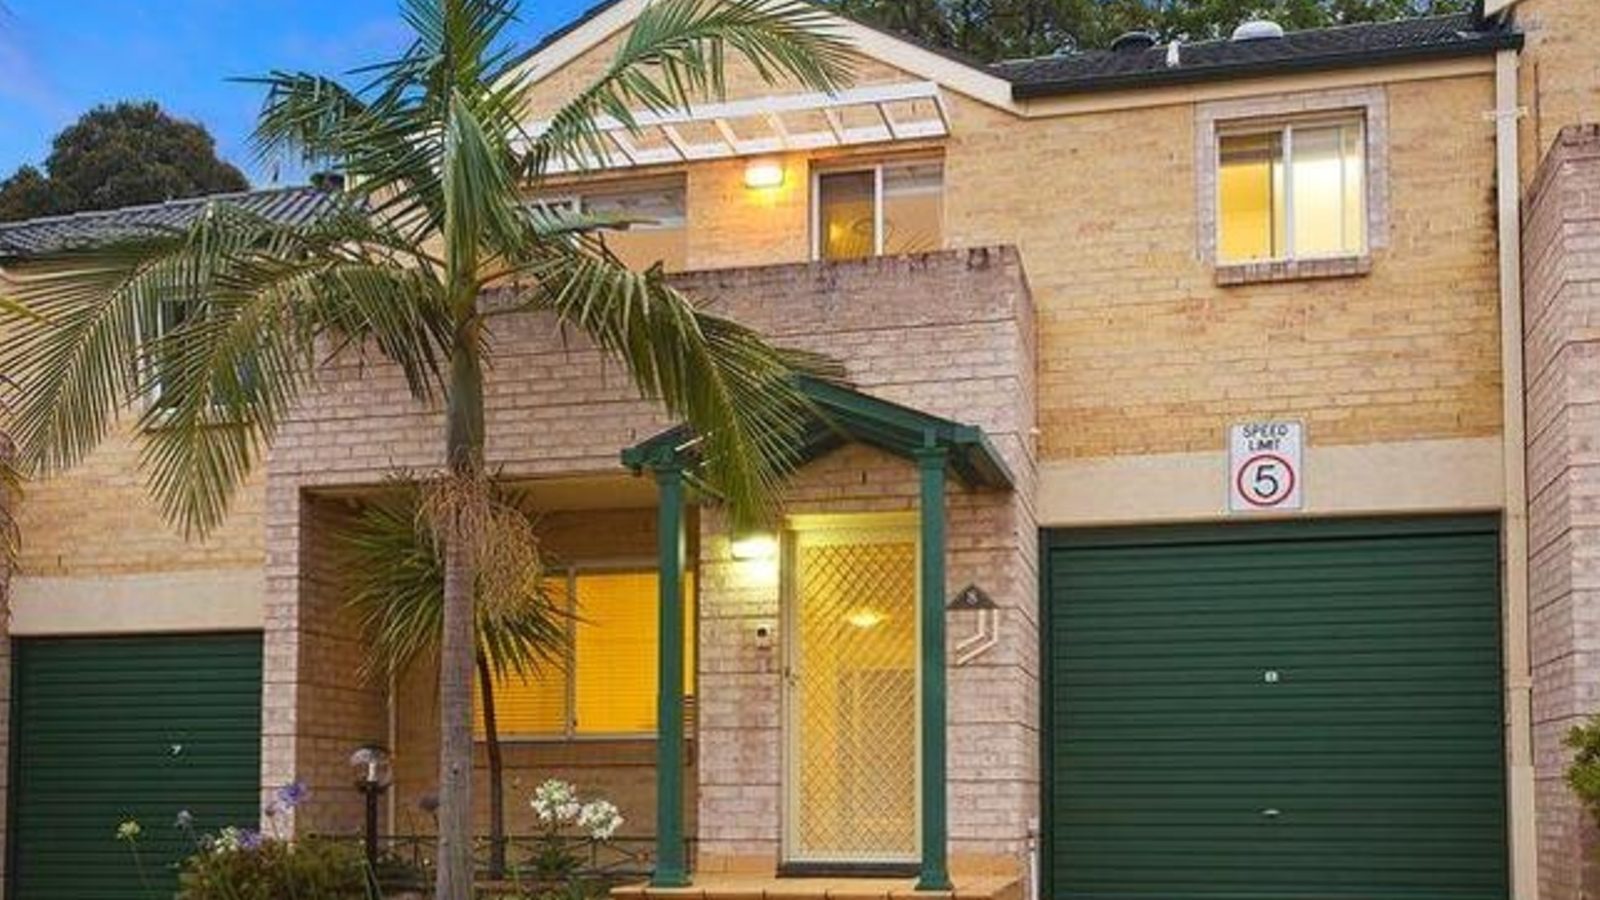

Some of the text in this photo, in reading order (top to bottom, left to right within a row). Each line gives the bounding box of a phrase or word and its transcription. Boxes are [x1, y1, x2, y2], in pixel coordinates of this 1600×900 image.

[1243, 424, 1289, 438] SPEED
[1248, 439, 1280, 450] LIMIT
[1253, 465, 1279, 498] 5
